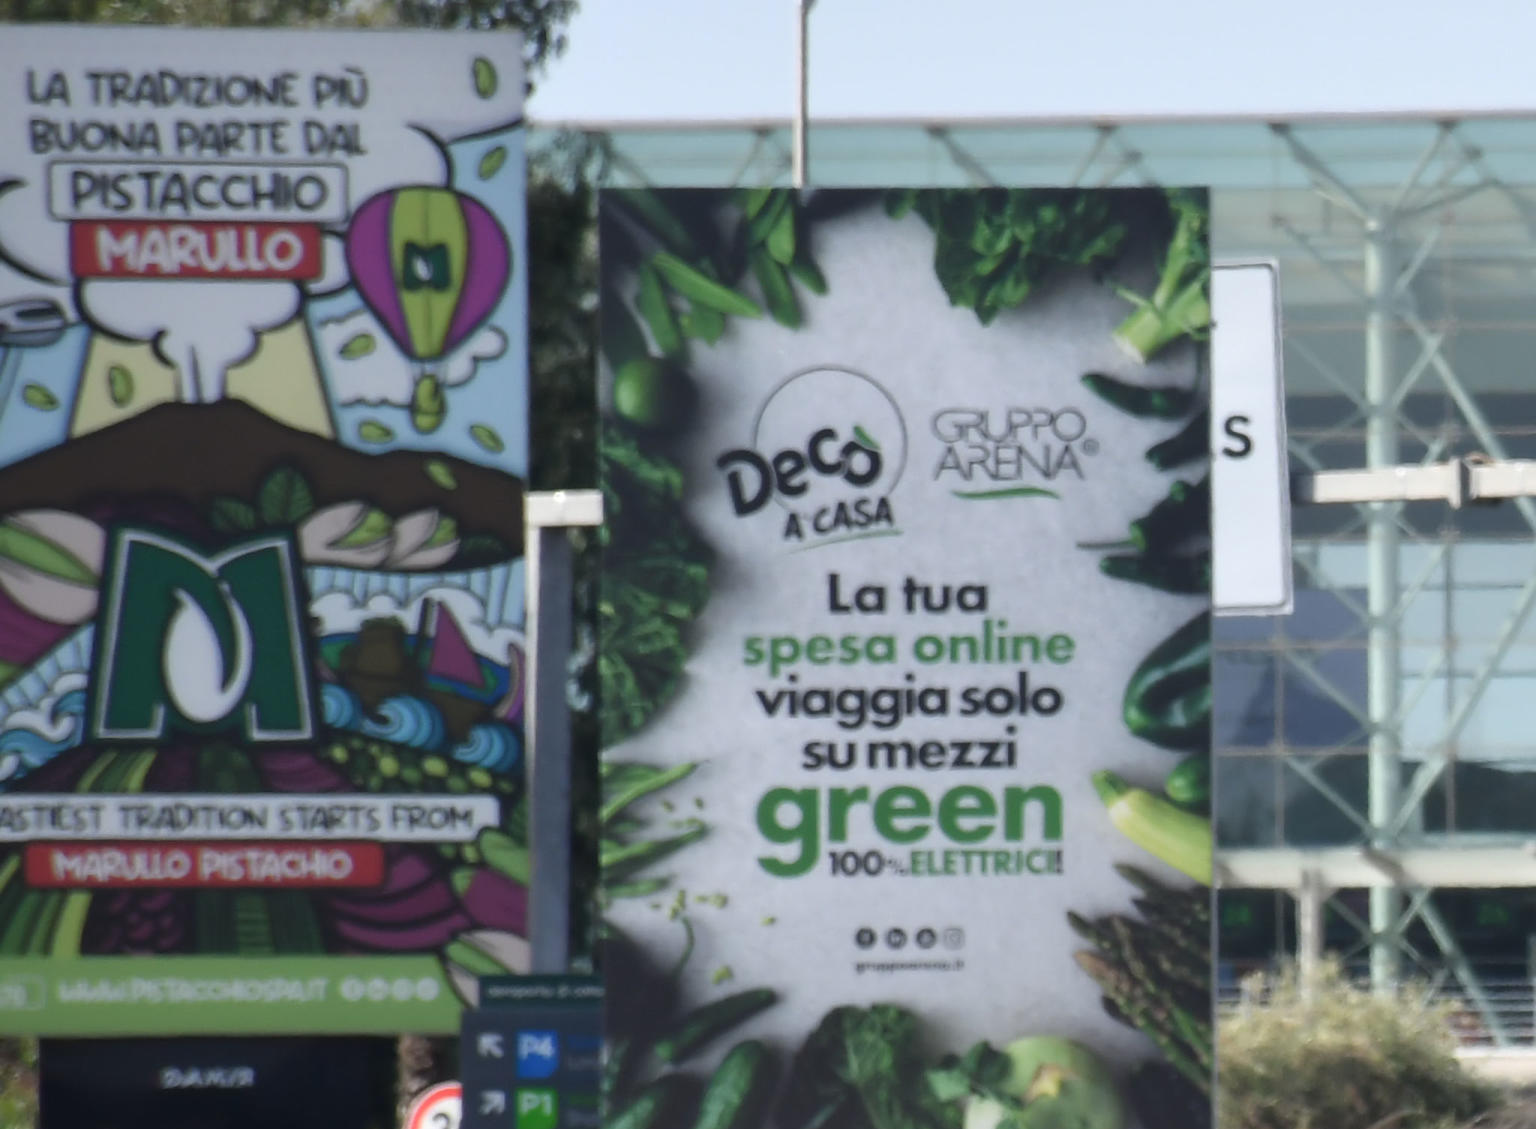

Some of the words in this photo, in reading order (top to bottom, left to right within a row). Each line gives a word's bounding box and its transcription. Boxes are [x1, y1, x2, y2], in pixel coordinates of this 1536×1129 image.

[25, 70, 70, 106] LA
[86, 70, 300, 108] TRADIZIONE
[314, 67, 369, 108] PIÙ
[29, 119, 162, 154] BUONA
[176, 119, 290, 155] PARTE
[304, 119, 368, 155] DAL
[70, 170, 328, 212] PISTACCHIO
[96, 227, 303, 273] MARULLO
[931, 408, 1087, 444] GRUPPO
[1222, 415, 1252, 458] S
[934, 444, 1083, 481] ARENA
[784, 513, 804, 540] A
[812, 497, 893, 533] CASA
[829, 573, 886, 614] La
[904, 575, 988, 614] tua
[743, 632, 895, 678] spesa
[913, 619, 1076, 666] online
[754, 672, 948, 730] viaggia
[960, 670, 1064, 717] solo
[802, 740, 855, 770] su
[868, 726, 1017, 770] mezzi
[120, 804, 267, 831] TRADITION
[280, 804, 381, 831] STARTS
[391, 804, 474, 830] FROM
[755, 783, 1064, 877] green
[51, 848, 191, 880] MARULLO
[200, 848, 352, 880] PISTACHIO
[521, 1036, 554, 1059] P4
[520, 1093, 553, 1117] P1
